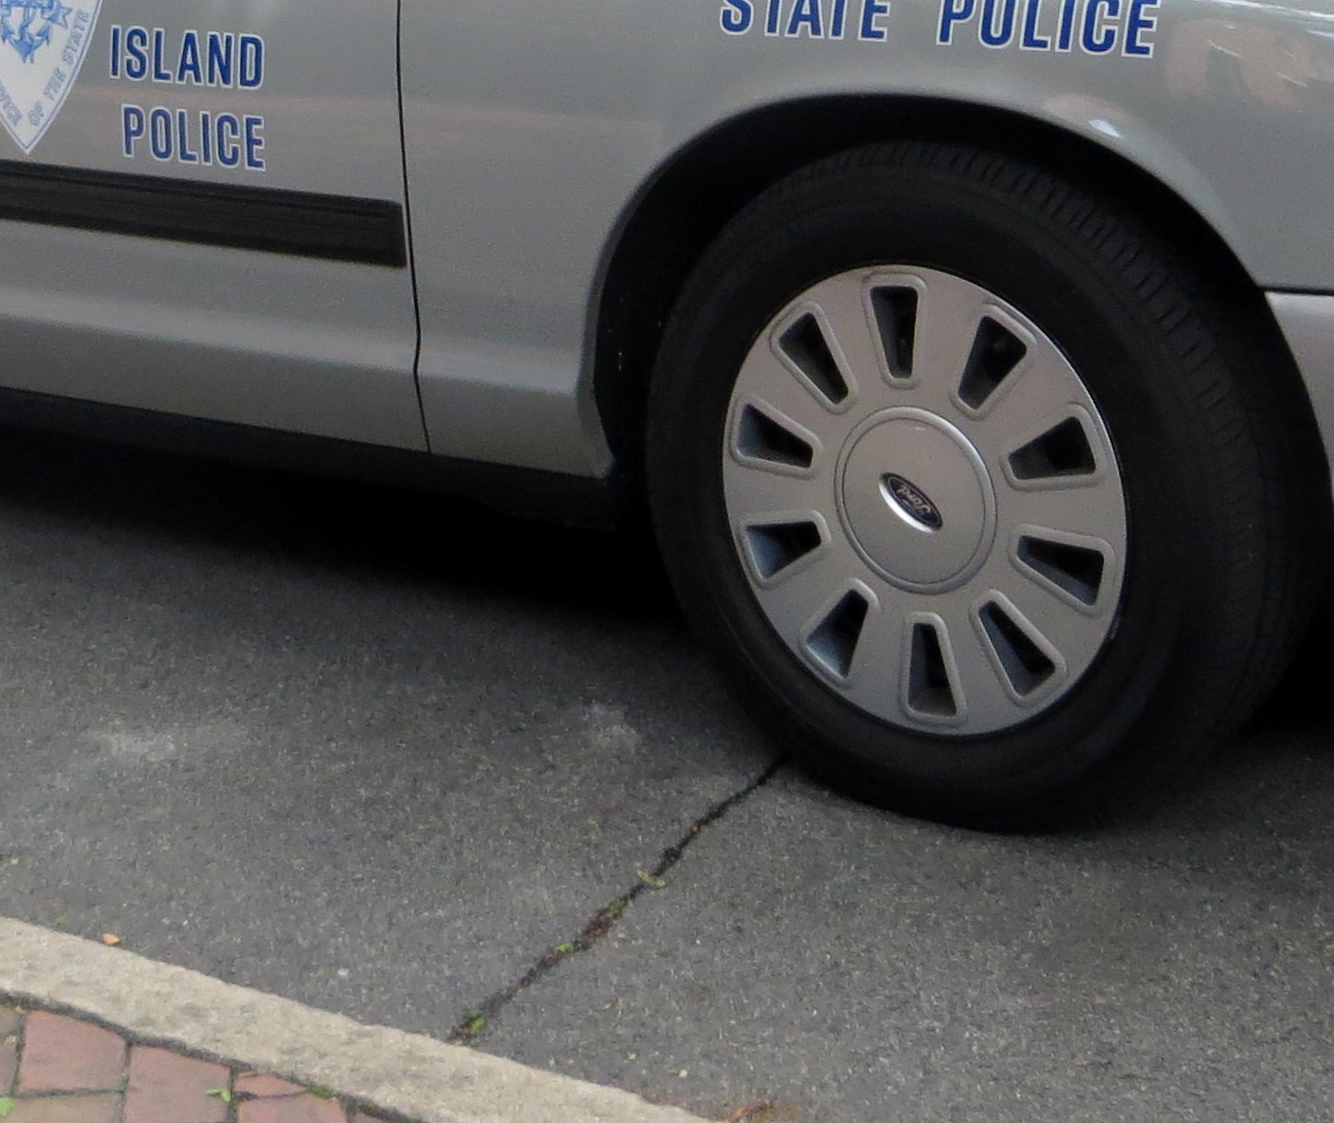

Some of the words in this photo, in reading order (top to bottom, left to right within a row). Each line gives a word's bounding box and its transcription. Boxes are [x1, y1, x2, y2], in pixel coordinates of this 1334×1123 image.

[110, 25, 265, 91] ISLAND
[122, 104, 266, 170] POLICE
[896, 482, 932, 516] Ford
